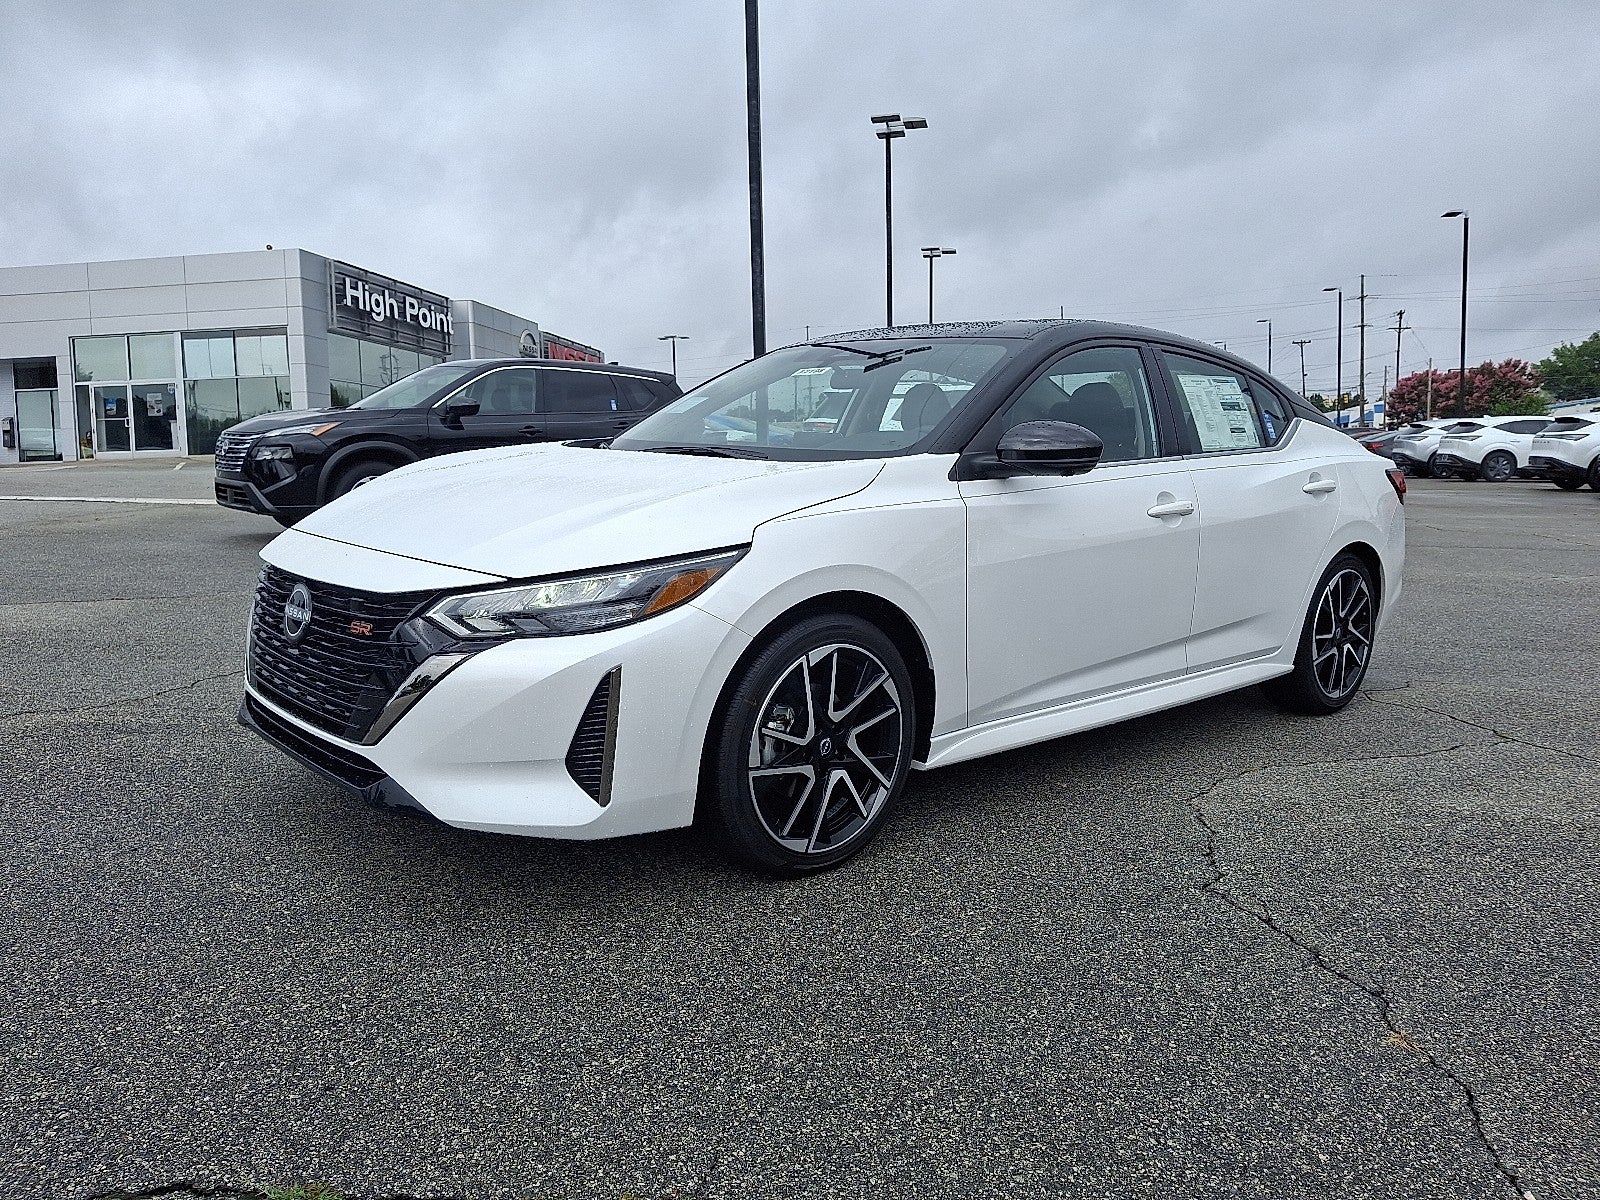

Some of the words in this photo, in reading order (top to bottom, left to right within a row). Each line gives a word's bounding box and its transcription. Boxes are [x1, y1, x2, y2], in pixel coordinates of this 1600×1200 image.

[345, 277, 399, 322] High
[405, 296, 454, 335] Point
[351, 621, 373, 636] SR
